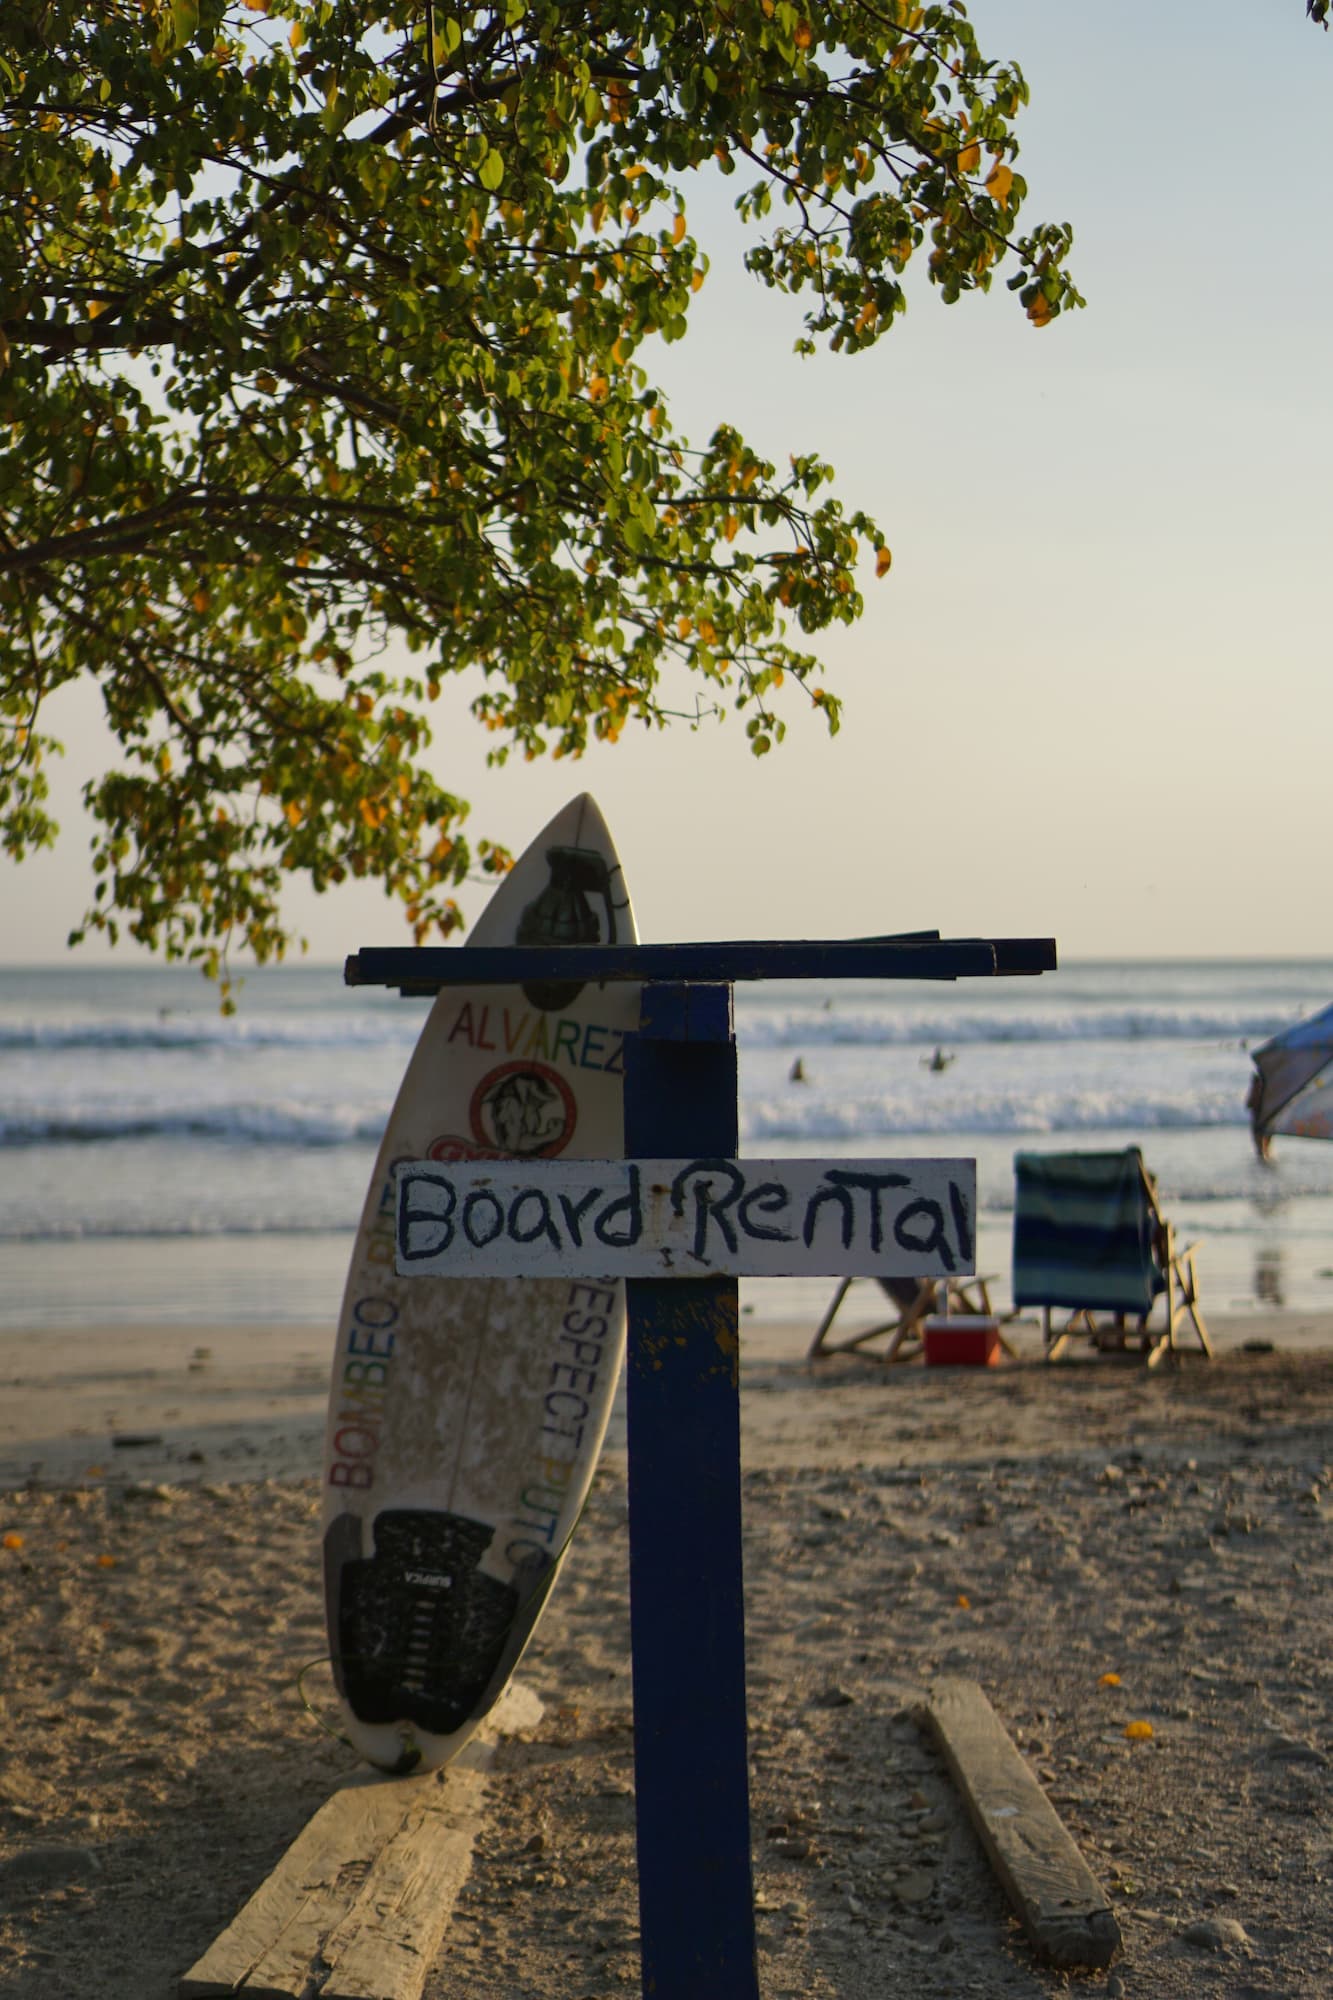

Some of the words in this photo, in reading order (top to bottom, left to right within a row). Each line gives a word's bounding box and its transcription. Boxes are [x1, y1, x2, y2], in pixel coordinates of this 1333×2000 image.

[447, 1000, 625, 1075] ALVAREZ
[398, 1163, 642, 1261] Board
[328, 1297, 399, 1490] BOMBEO
[542, 1277, 619, 1450] ESPECT
